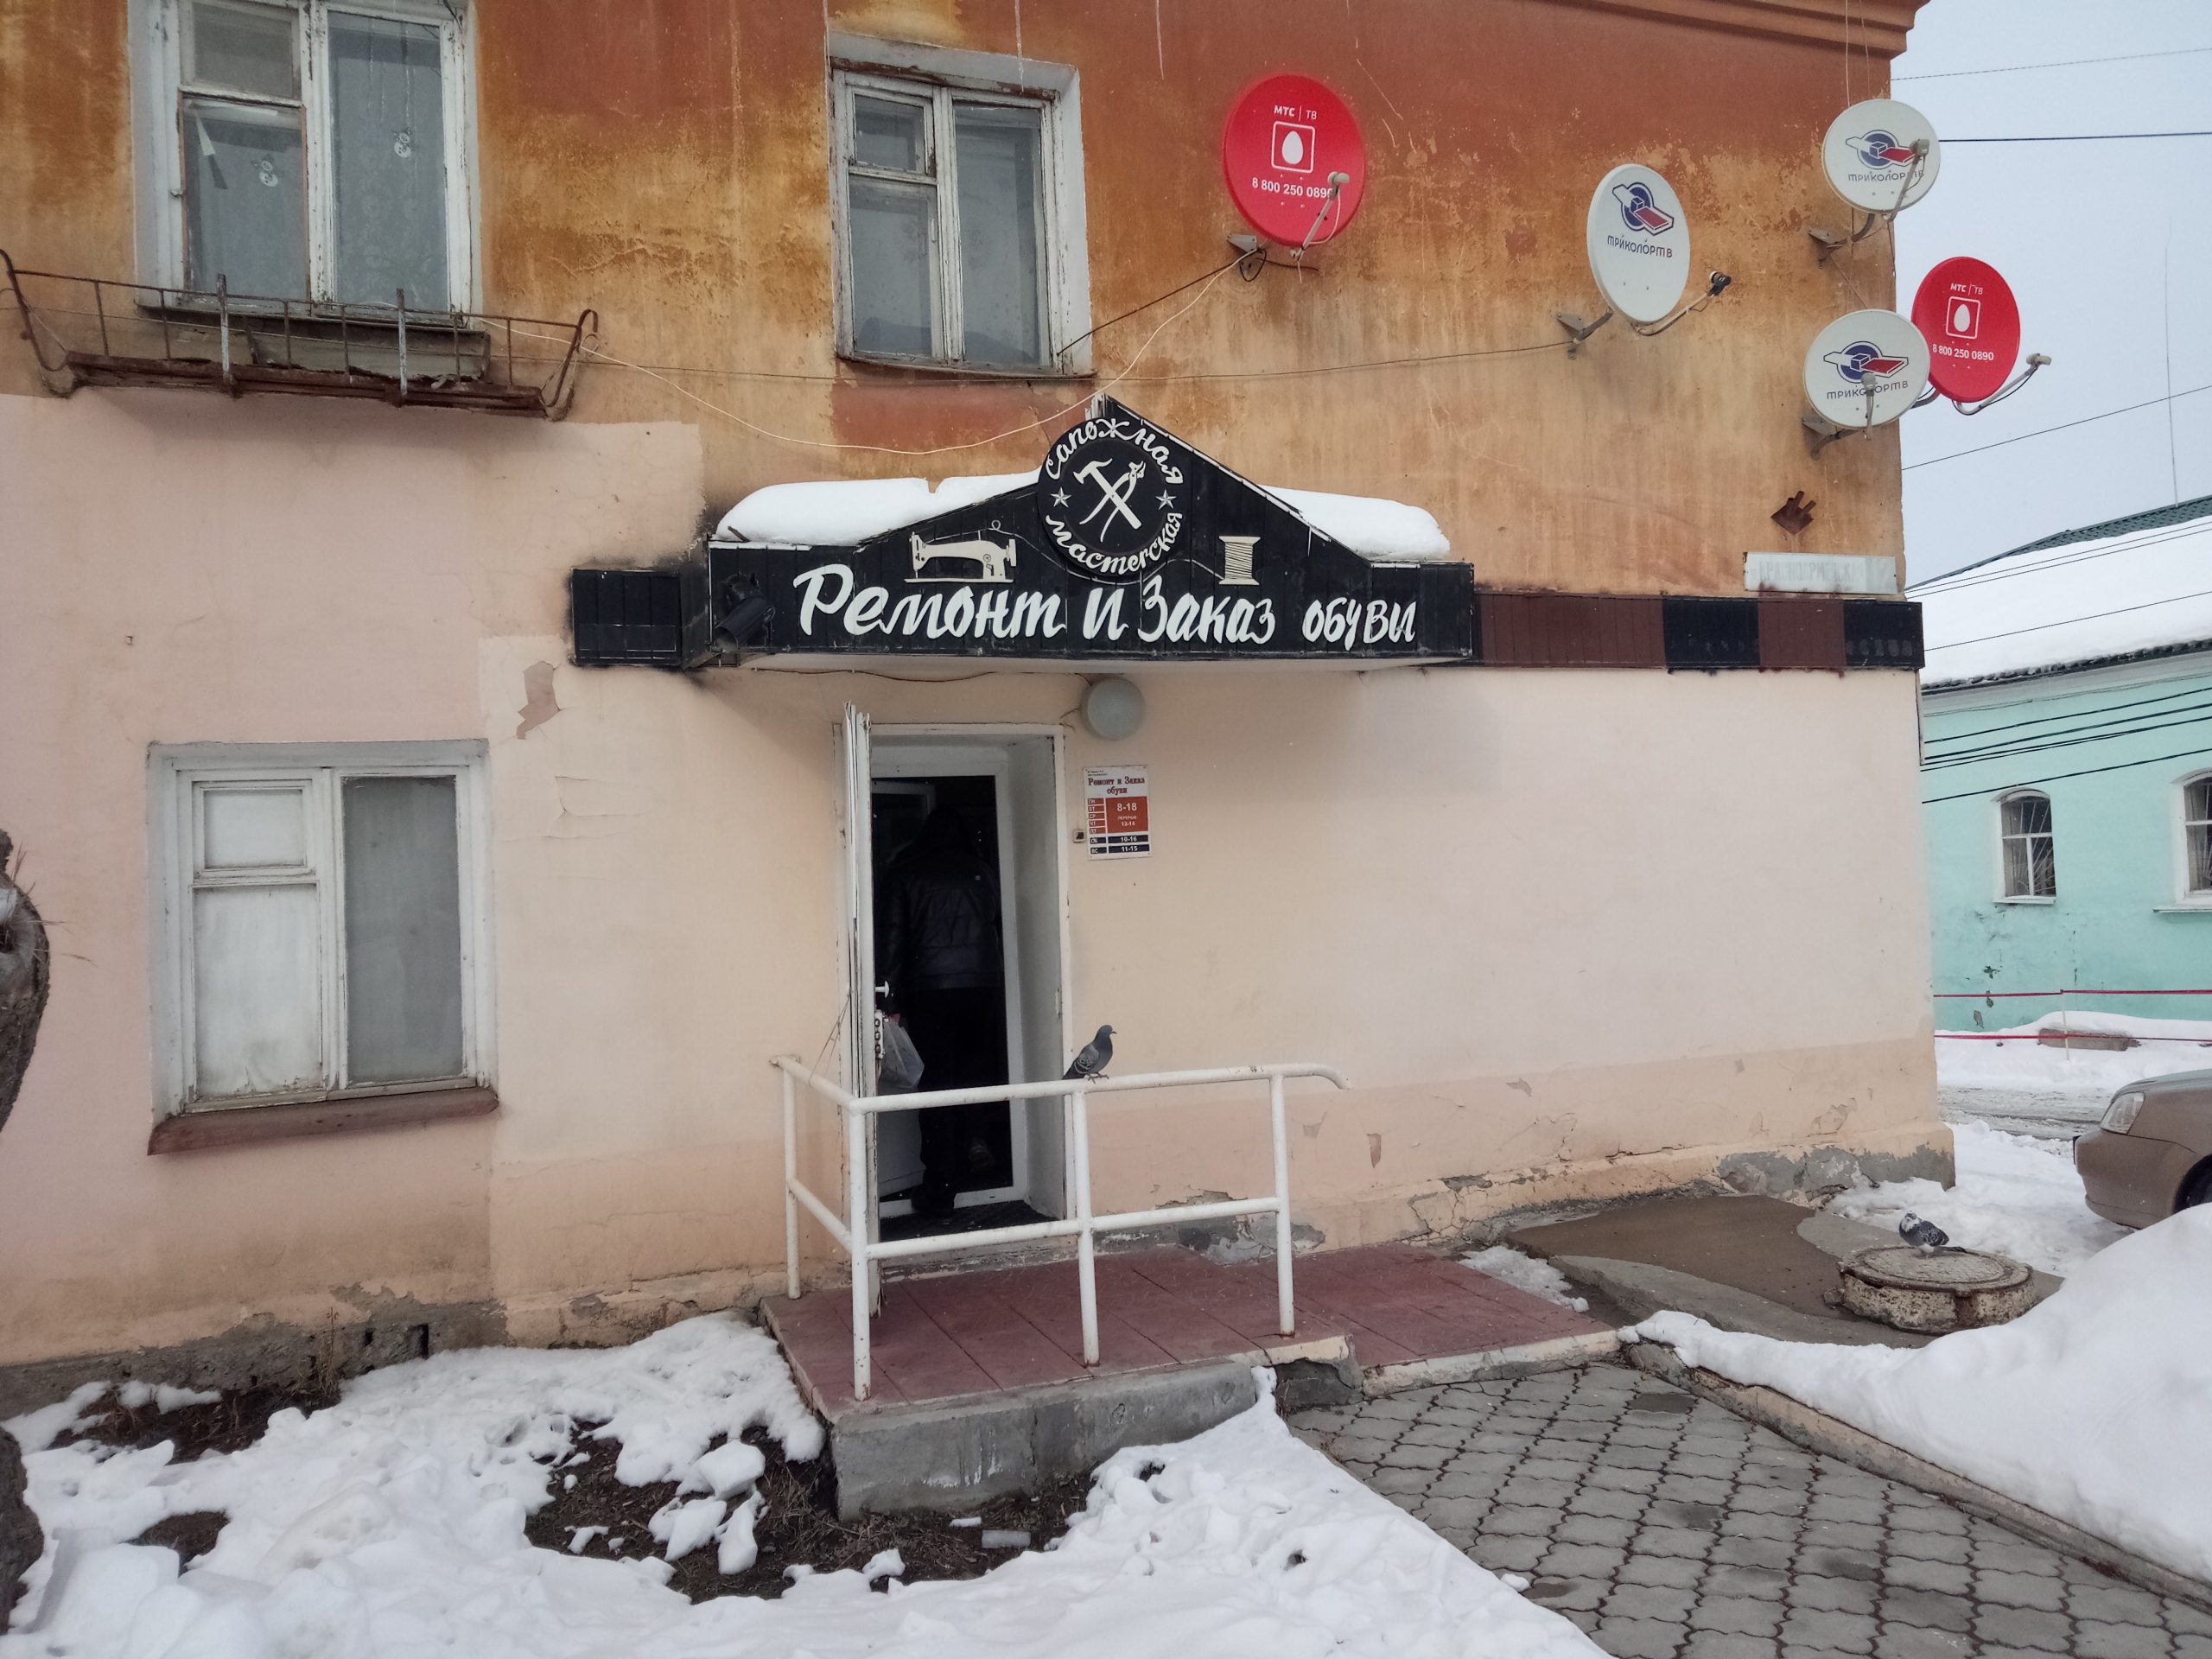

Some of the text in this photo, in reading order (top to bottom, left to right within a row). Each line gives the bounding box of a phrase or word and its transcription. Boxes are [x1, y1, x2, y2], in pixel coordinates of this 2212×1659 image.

[1274, 105, 1317, 120] МТС ТВ
[1252, 177, 1259, 188] 8
[1262, 180, 1281, 193] 800
[1283, 183, 1303, 196] 250
[1950, 283, 1983, 295] МТС ТВ
[1932, 344, 1994, 361] 8 800 250 0890
[792, 563, 1066, 639] Ремонт
[1137, 575, 1276, 645] Заказ
[1117, 803, 1137, 811] 8-18
